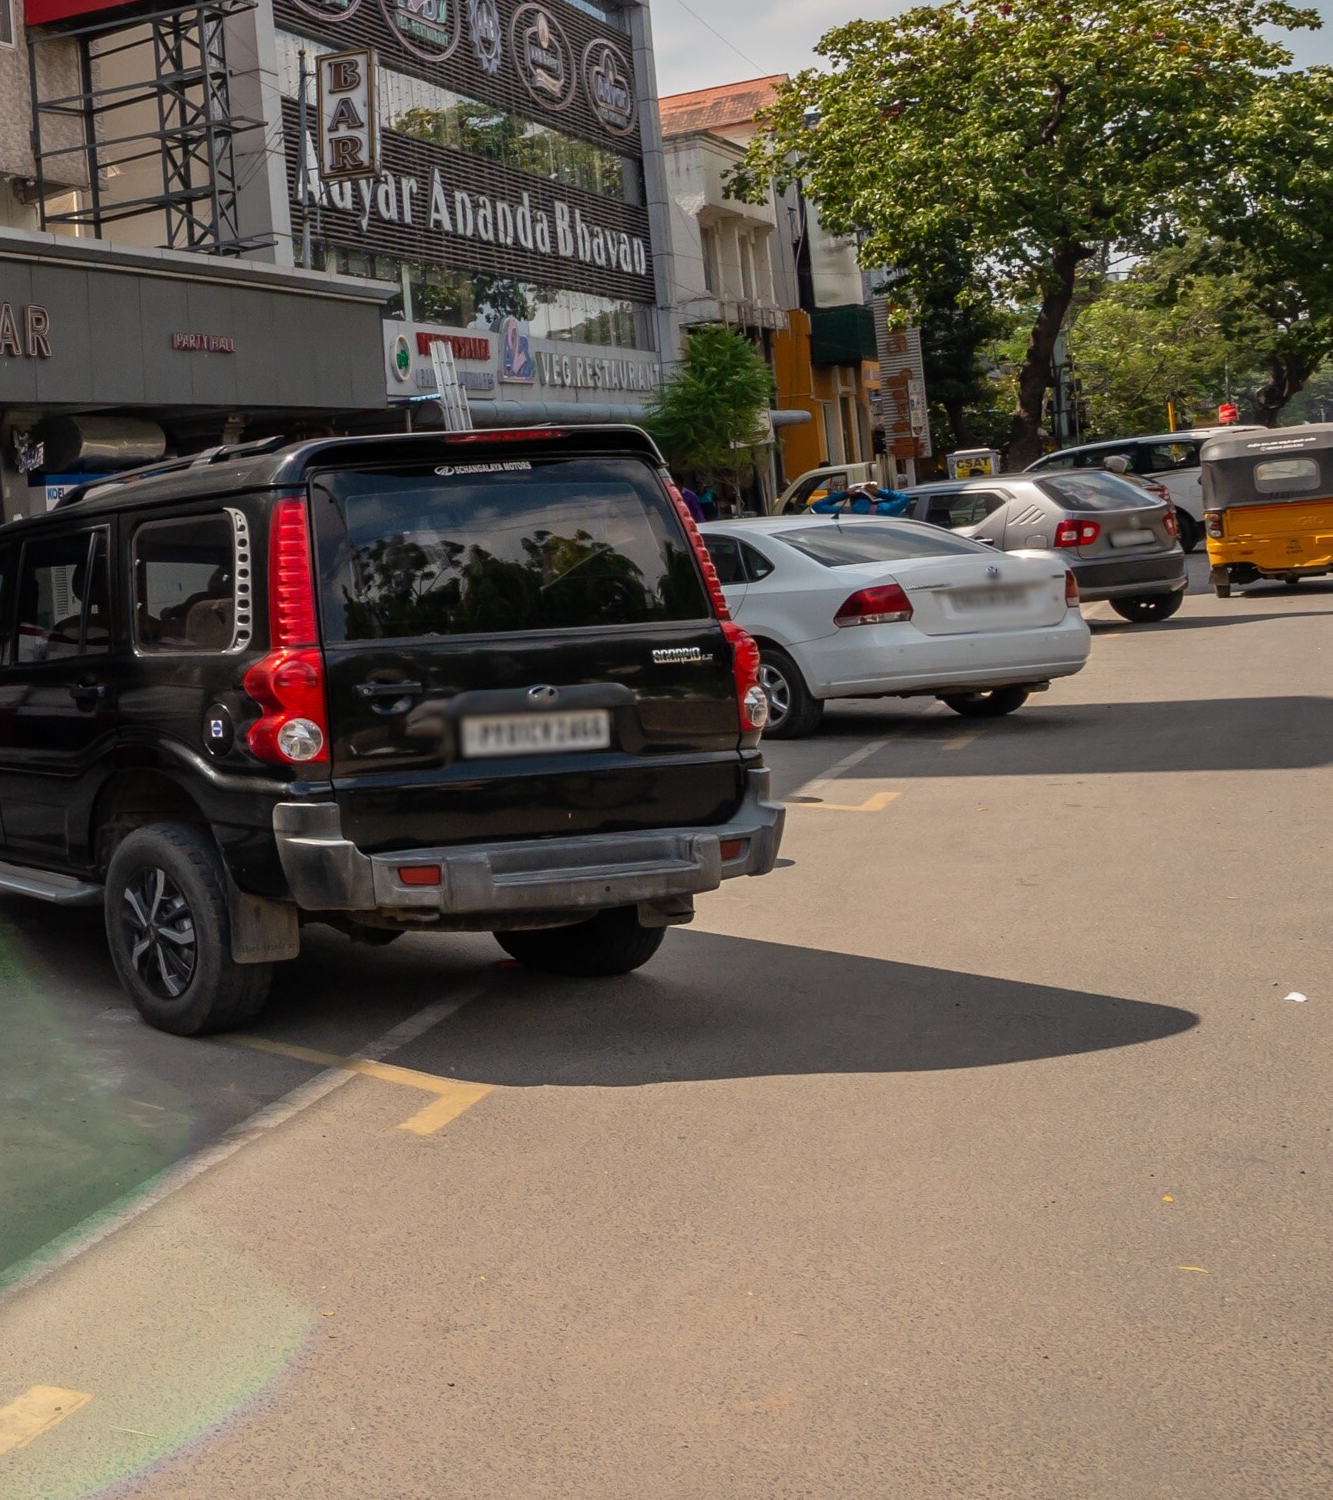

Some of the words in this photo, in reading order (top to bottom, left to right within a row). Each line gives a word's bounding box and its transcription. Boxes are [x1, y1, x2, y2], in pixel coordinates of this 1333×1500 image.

[327, 59, 365, 171] BAR
[428, 167, 551, 254] Ananda
[554, 201, 647, 275] Bhavan
[172, 332, 208, 351] PARTY
[208, 336, 236, 353] HALL
[503, 461, 532, 471] MOTORS
[652, 647, 701, 664] SCORPIO
